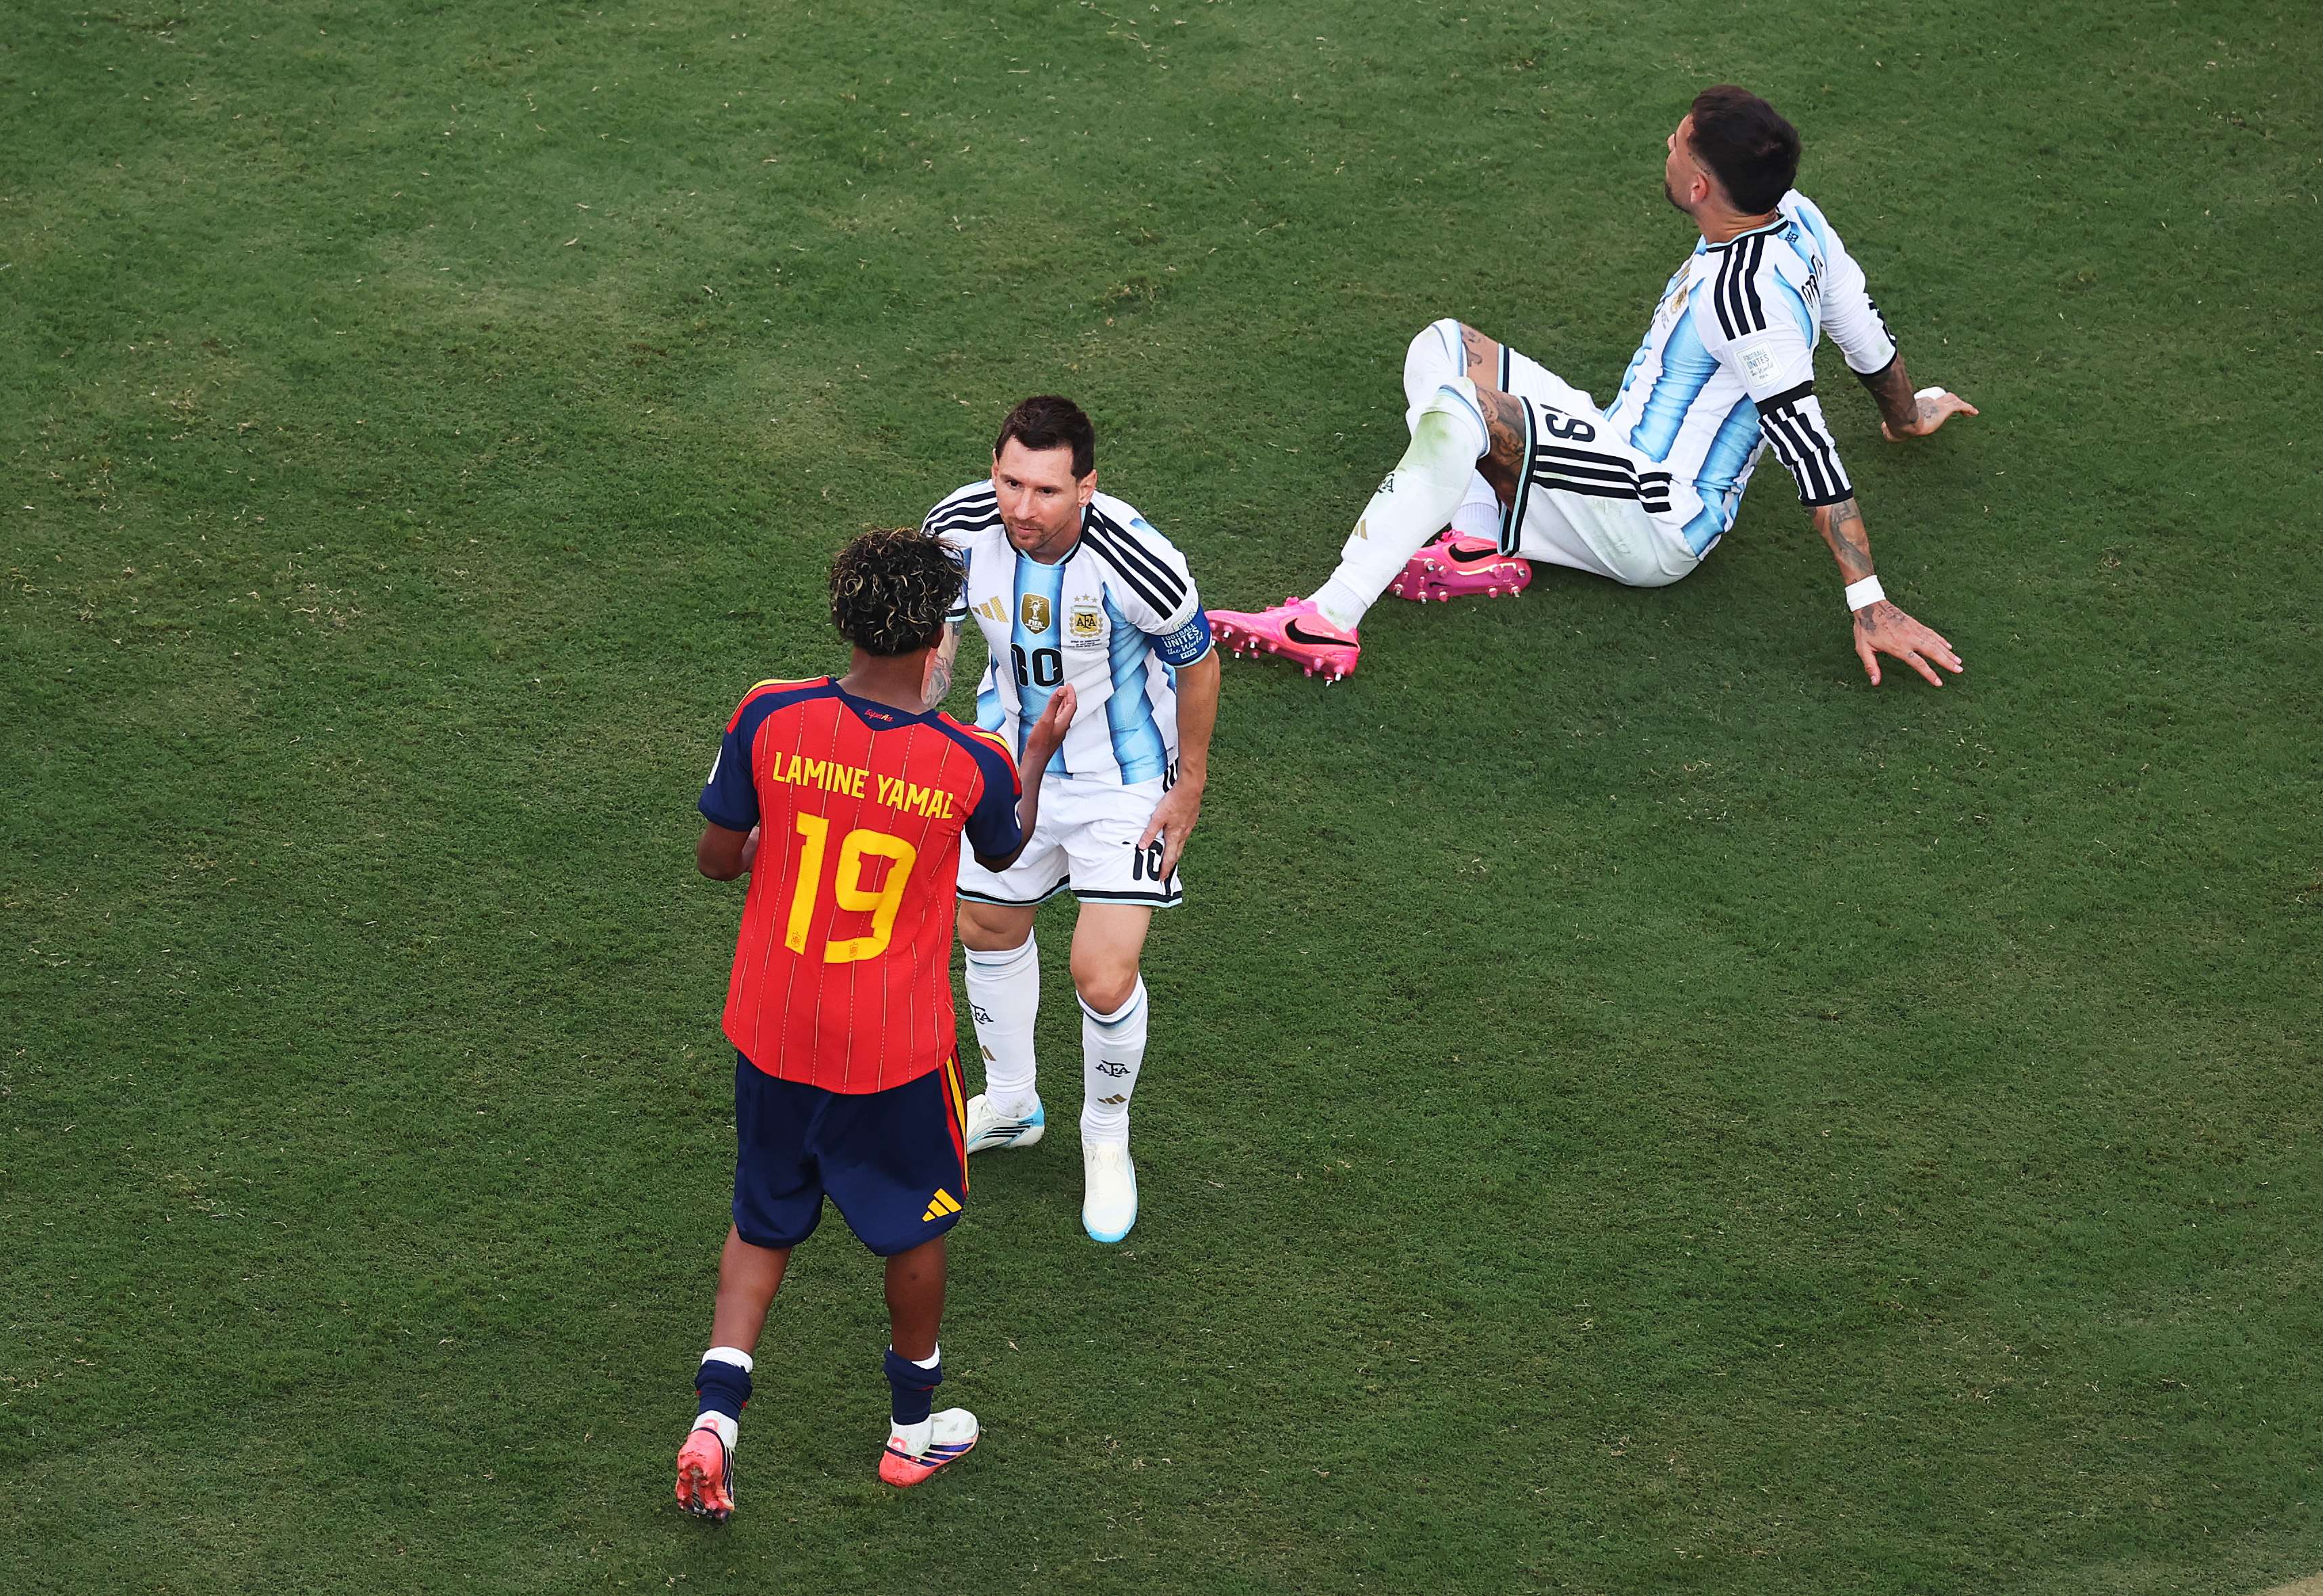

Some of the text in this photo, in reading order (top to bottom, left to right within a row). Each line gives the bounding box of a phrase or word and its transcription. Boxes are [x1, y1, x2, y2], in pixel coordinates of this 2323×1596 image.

[1076, 613, 1097, 630] AFA
[1164, 627, 1199, 648] UNITES
[1181, 632, 1204, 651] World
[1011, 644, 1064, 687] 10
[772, 752, 954, 819] LAMINE YAMAL
[1123, 840, 1164, 881] 10
[784, 811, 918, 964] 19
[968, 999, 994, 1025] FA
[1095, 1059, 1131, 1078] AFA
